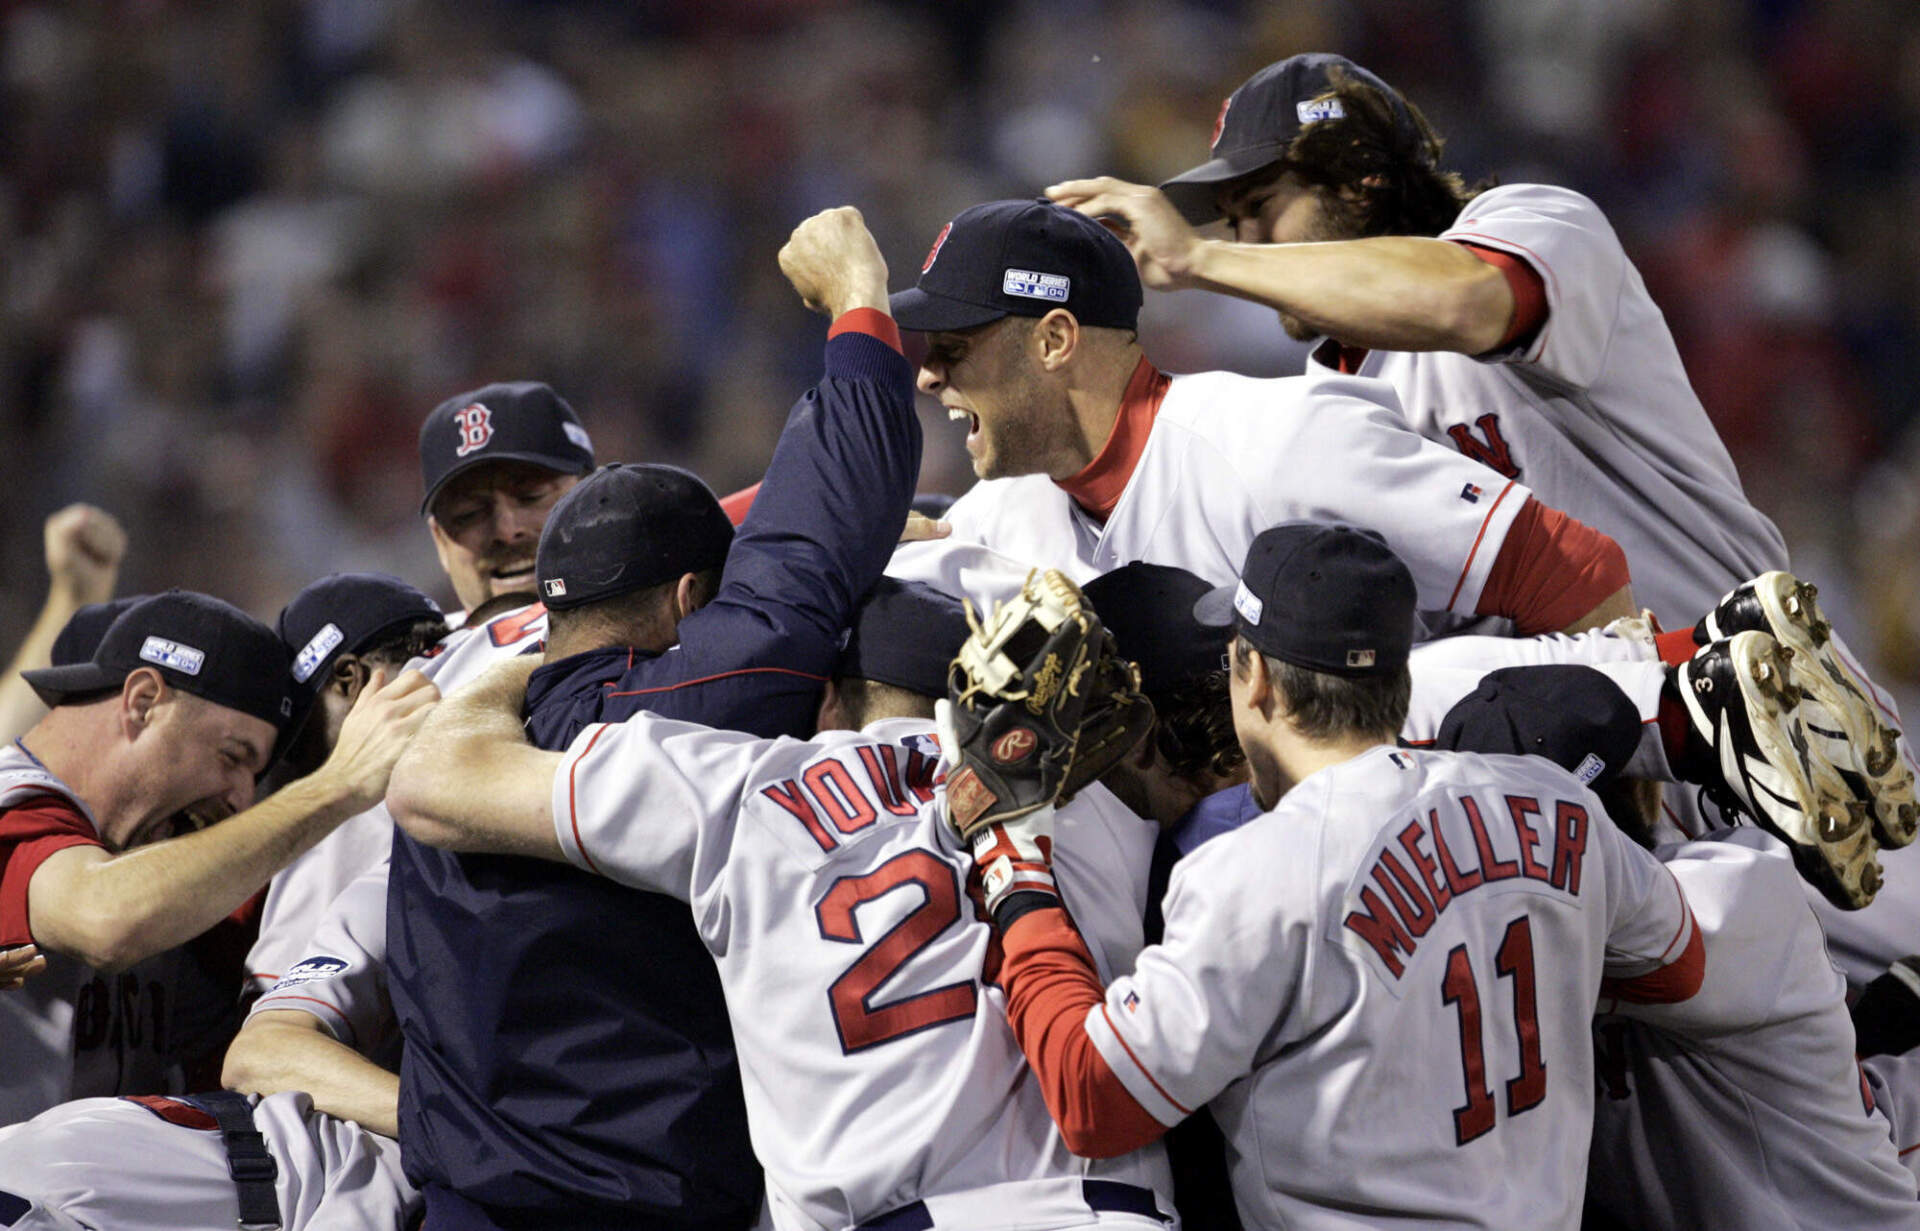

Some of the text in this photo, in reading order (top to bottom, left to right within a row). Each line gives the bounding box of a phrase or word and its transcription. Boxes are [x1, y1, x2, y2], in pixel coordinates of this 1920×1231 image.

[1007, 271, 1039, 283] WORLD
[454, 402, 495, 457] B
[815, 847, 1004, 1056] 2
[1344, 794, 1589, 981] MUELLER
[1441, 914, 1547, 1147] 11
